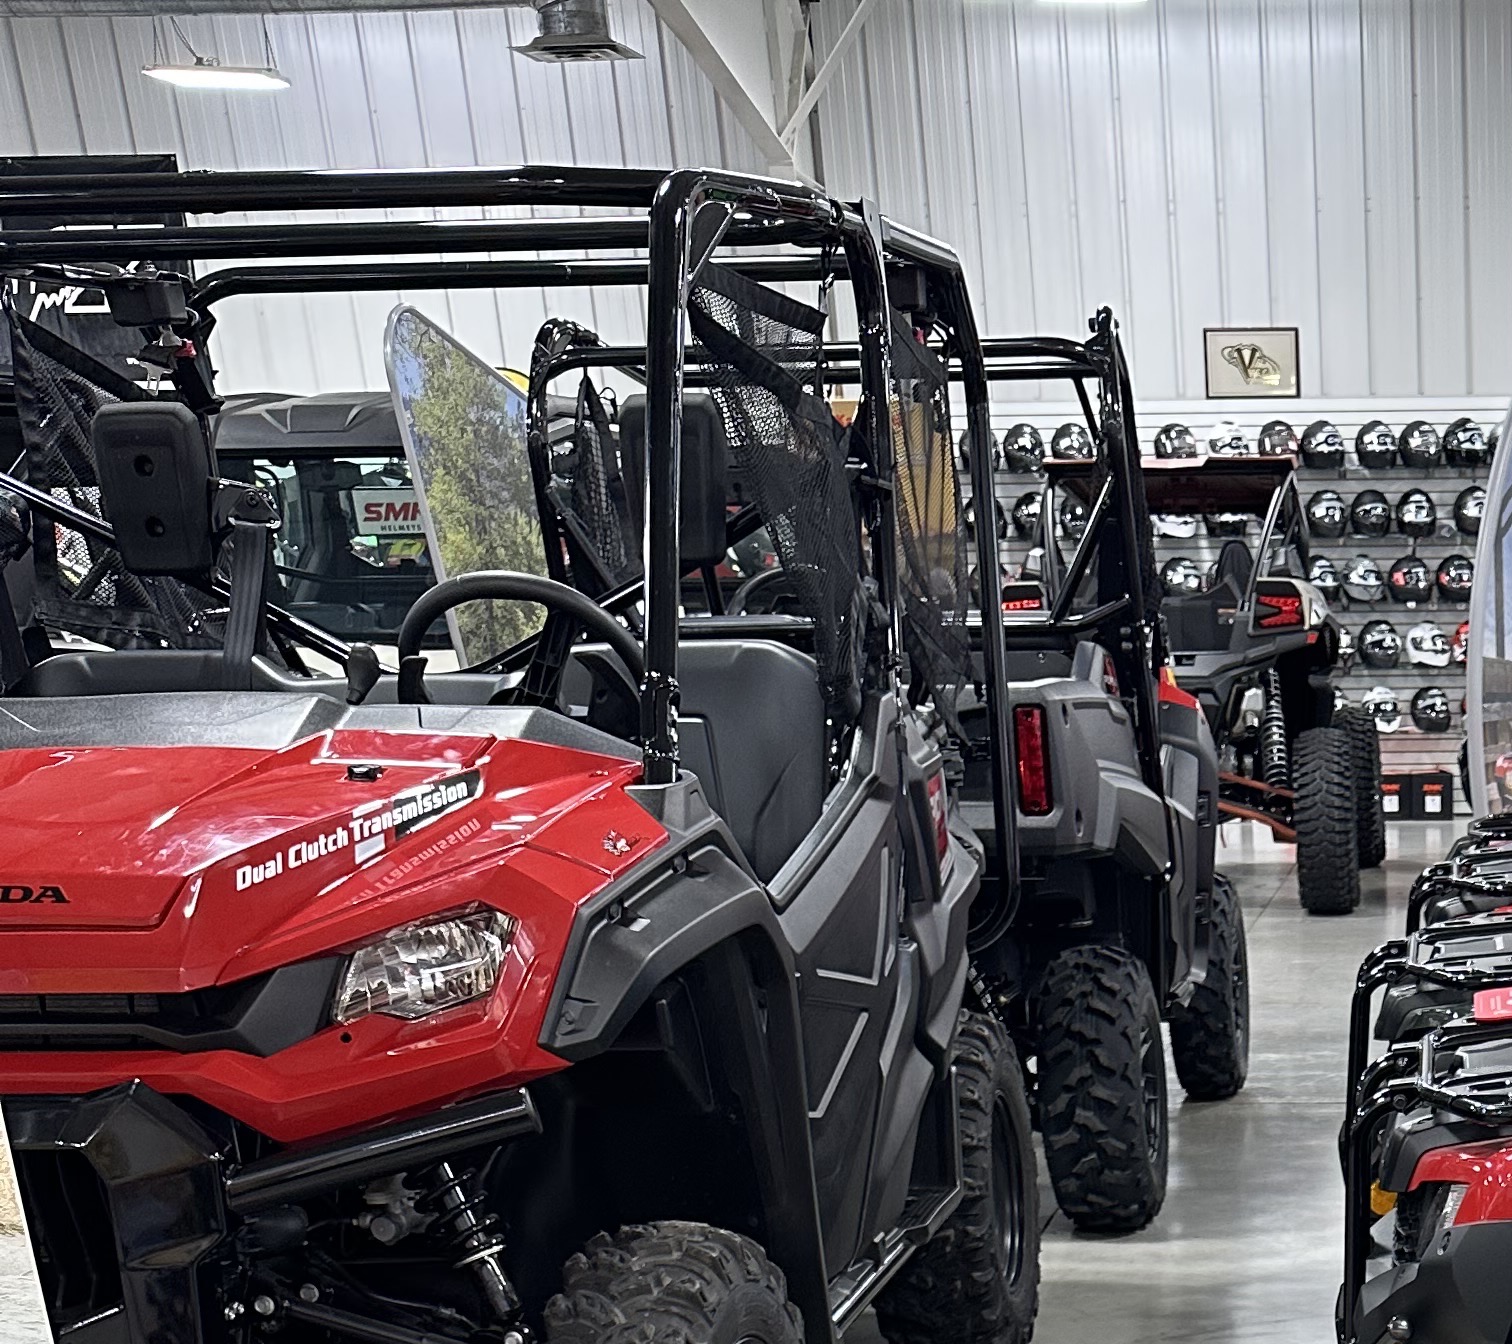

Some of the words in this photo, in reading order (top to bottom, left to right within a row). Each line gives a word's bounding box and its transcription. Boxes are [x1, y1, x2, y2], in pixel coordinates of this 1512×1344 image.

[380, 524, 422, 532] HELMETS
[236, 851, 283, 892] Dual
[288, 827, 349, 869] Clutch
[349, 781, 468, 842] Transmission
